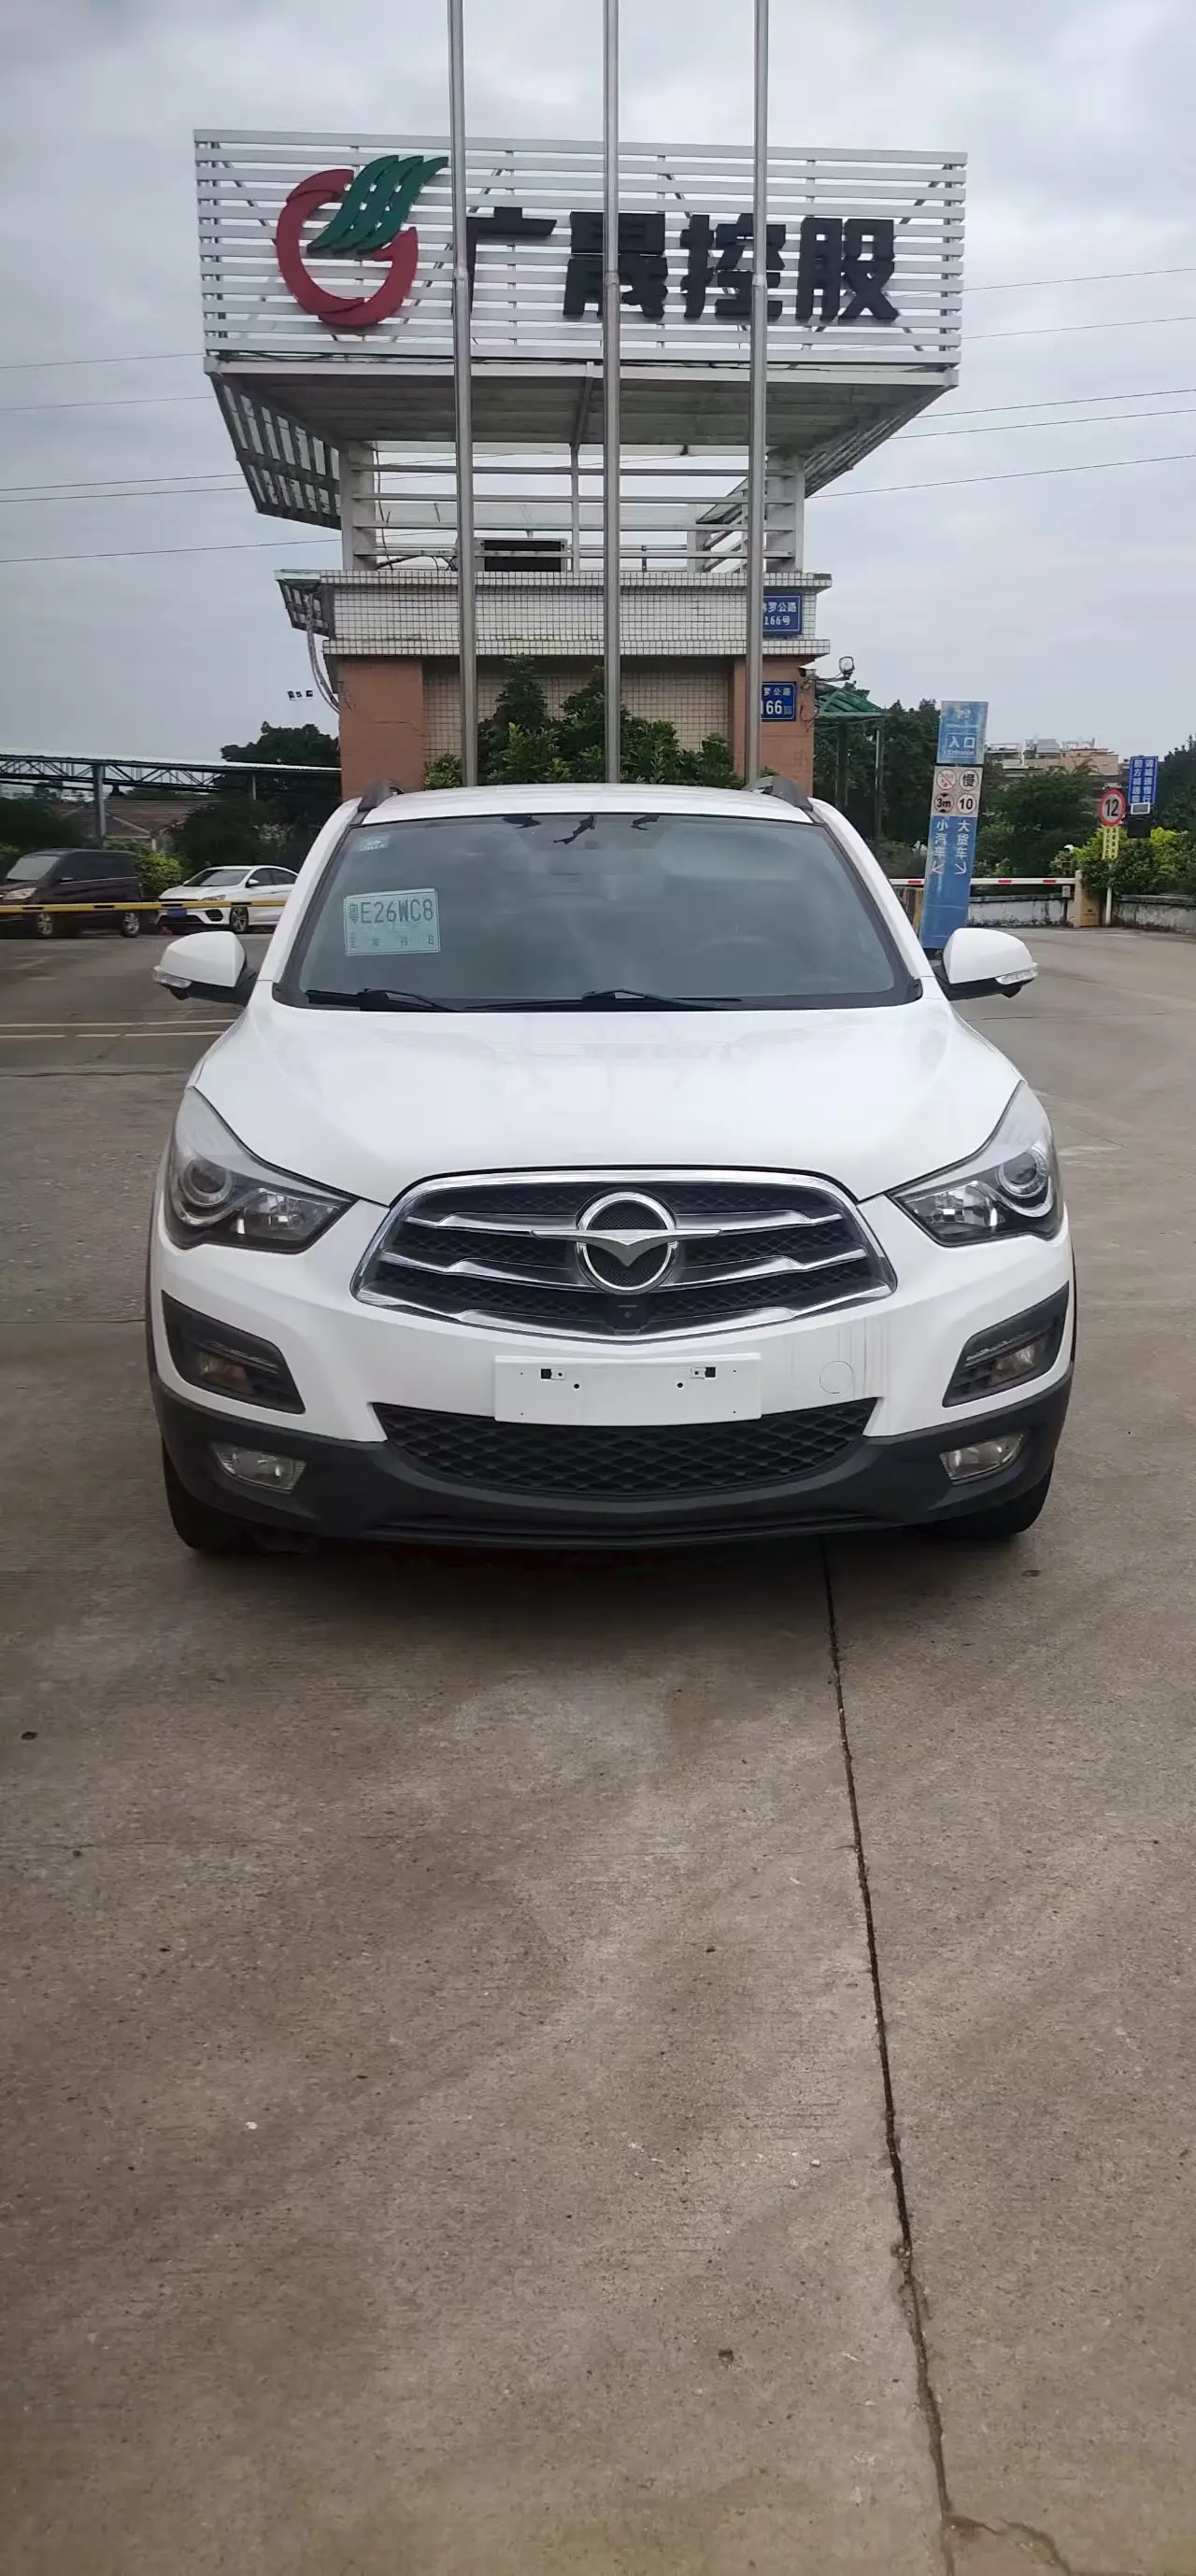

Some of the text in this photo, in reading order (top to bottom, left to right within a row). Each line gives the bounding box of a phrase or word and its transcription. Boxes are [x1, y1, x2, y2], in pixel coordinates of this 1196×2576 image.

[465, 205, 901, 321] 广晟控股
[764, 616, 790, 626] 166号
[948, 736, 975, 748] 入口
[962, 773, 975, 786] 慢
[936, 798, 951, 808] 3m
[960, 799, 973, 810] 10
[1104, 799, 1119, 817] 12
[934, 818, 948, 857] 小汽车
[956, 819, 971, 858] 大货车
[349, 899, 434, 924] 粤E26WC8
